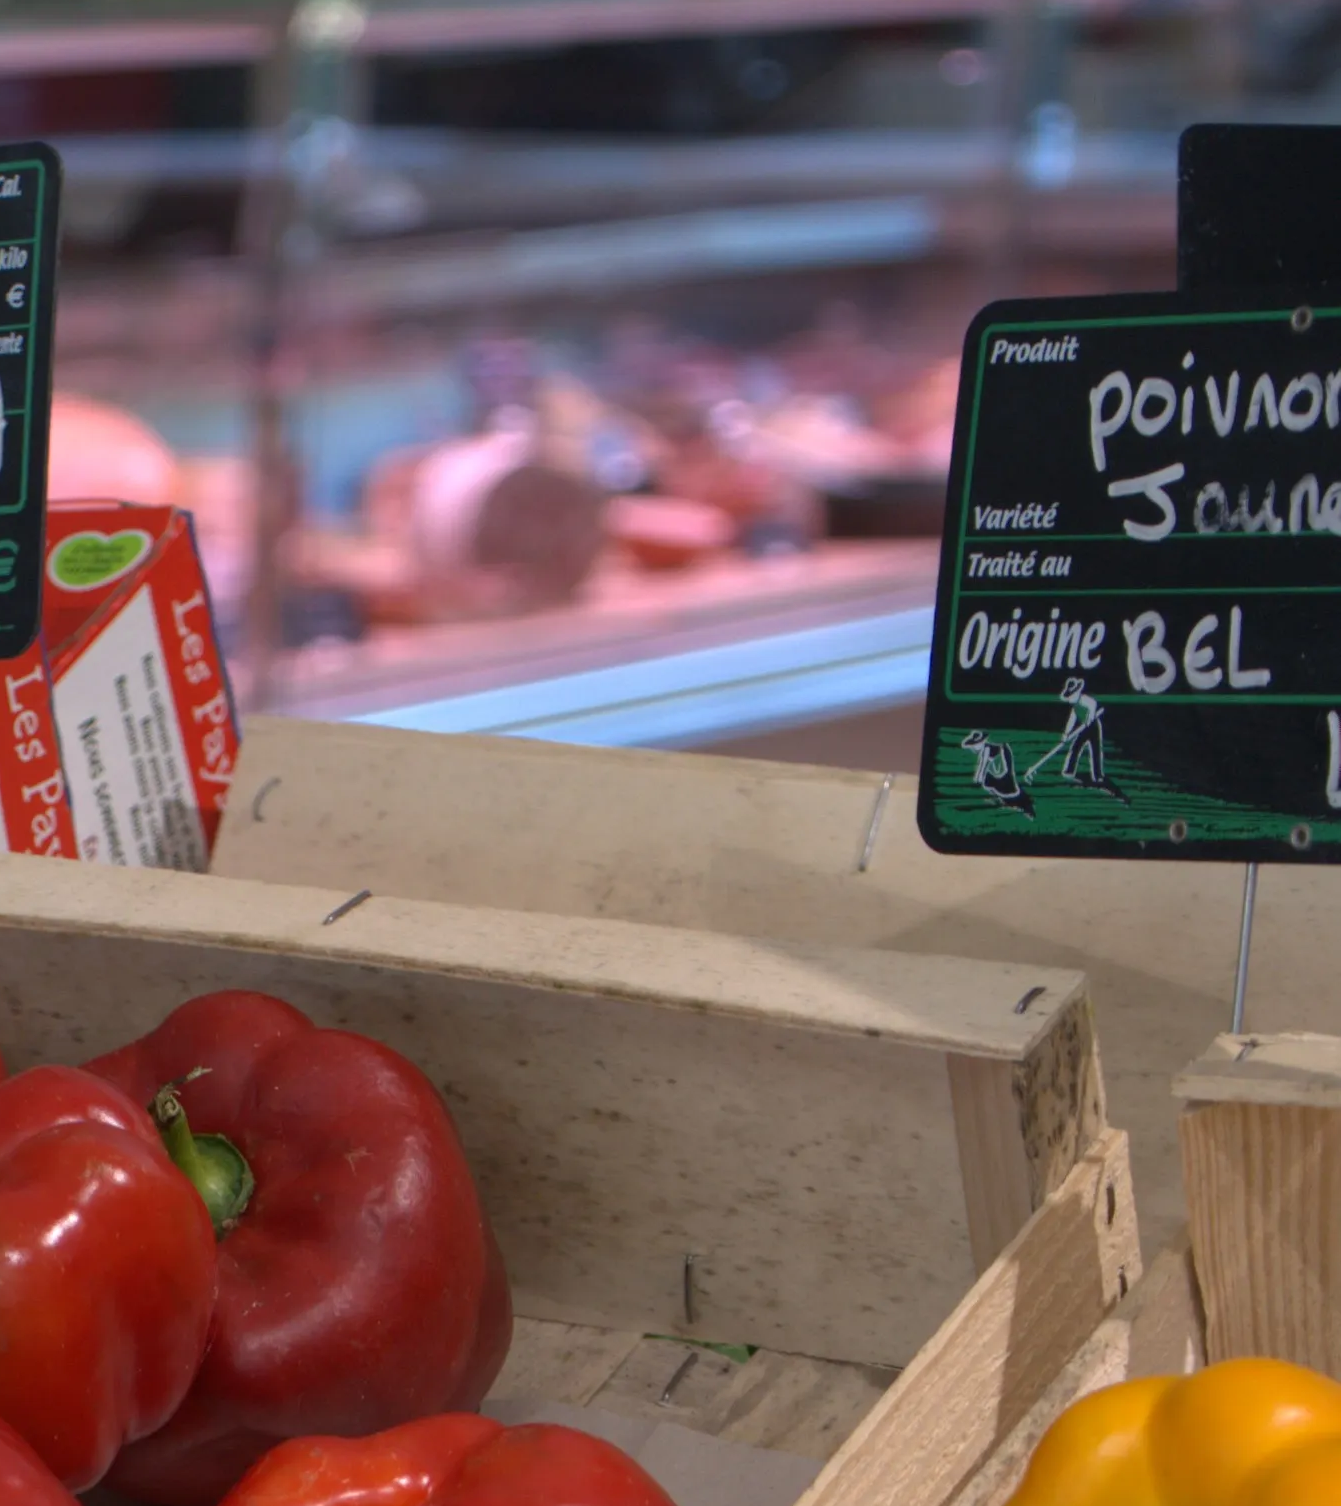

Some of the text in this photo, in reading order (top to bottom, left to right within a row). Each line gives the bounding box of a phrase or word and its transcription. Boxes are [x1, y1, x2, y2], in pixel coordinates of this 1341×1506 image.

[6, 282, 26, 308] €
[990, 336, 1080, 365] Produit
[973, 502, 1060, 531] Variété
[968, 551, 1072, 578] Traité au
[173, 590, 213, 684] Les
[959, 605, 1271, 694] Origine BEL
[5, 664, 47, 763] Les
